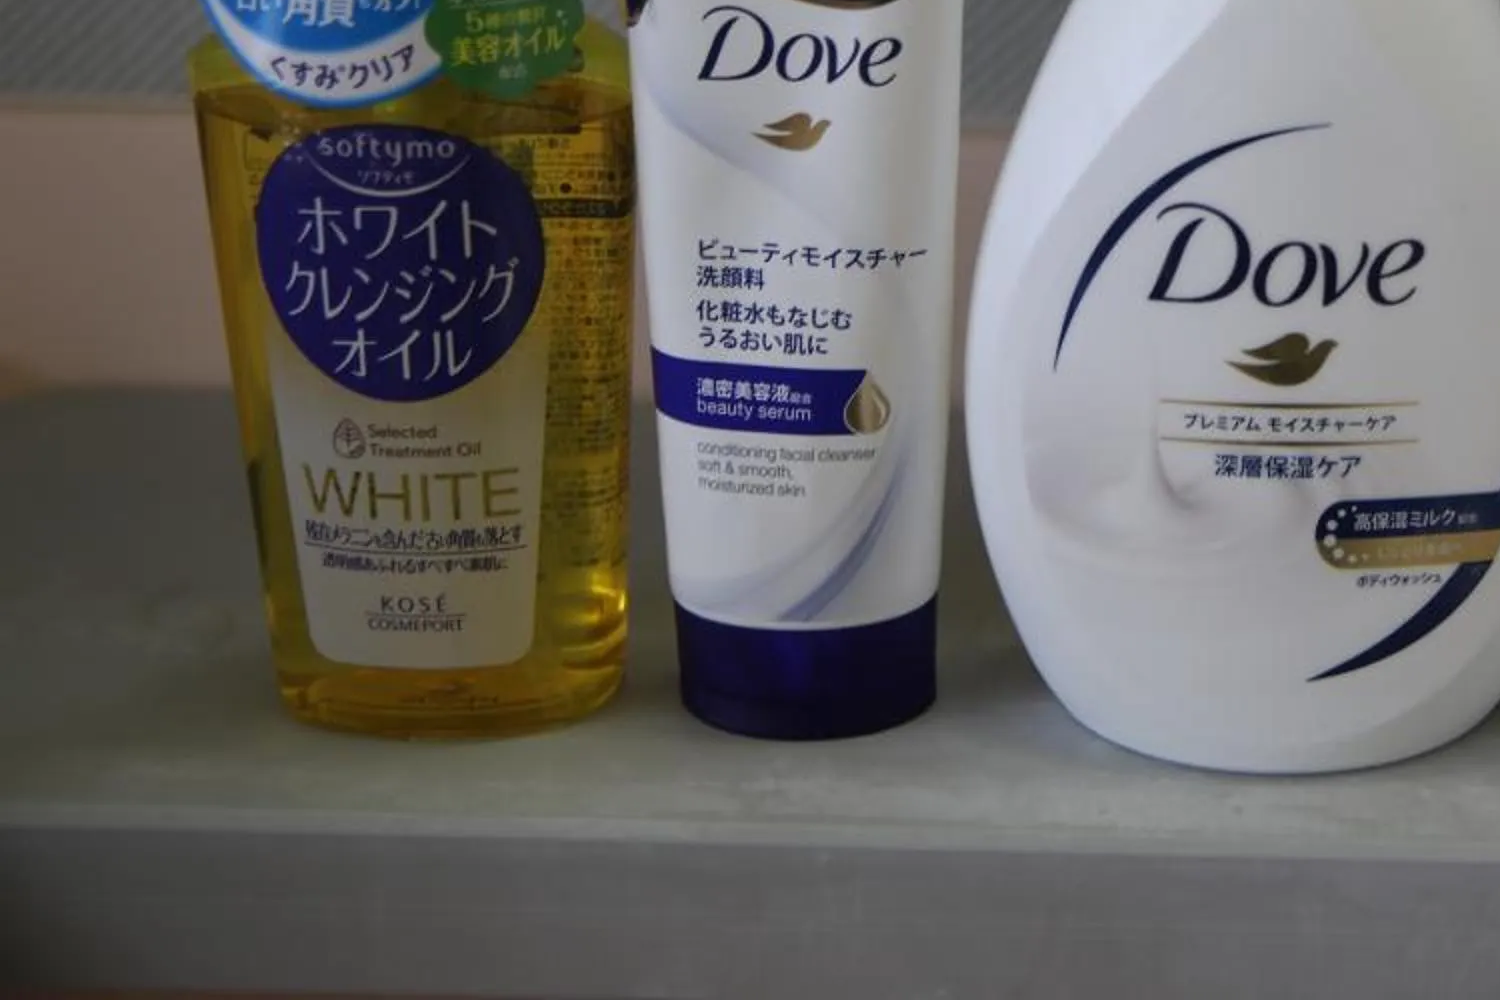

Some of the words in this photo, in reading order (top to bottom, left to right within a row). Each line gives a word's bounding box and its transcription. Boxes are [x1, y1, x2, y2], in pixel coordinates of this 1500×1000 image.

[697, 5, 904, 88] Dove
[317, 131, 456, 168] softymo
[298, 196, 498, 261] ホワイト
[696, 265, 765, 290] 洗顔料
[1147, 201, 1427, 309] Dove
[285, 255, 521, 324] クレンジング
[696, 299, 853, 331] 化粧水もなじむ
[331, 327, 473, 381] オイル
[699, 326, 829, 356] うるおい肌に
[697, 400, 753, 421] beauty
[757, 404, 812, 422] serum
[1214, 453, 1362, 480] 深層保湿ケア
[302, 463, 522, 521] WHITE
